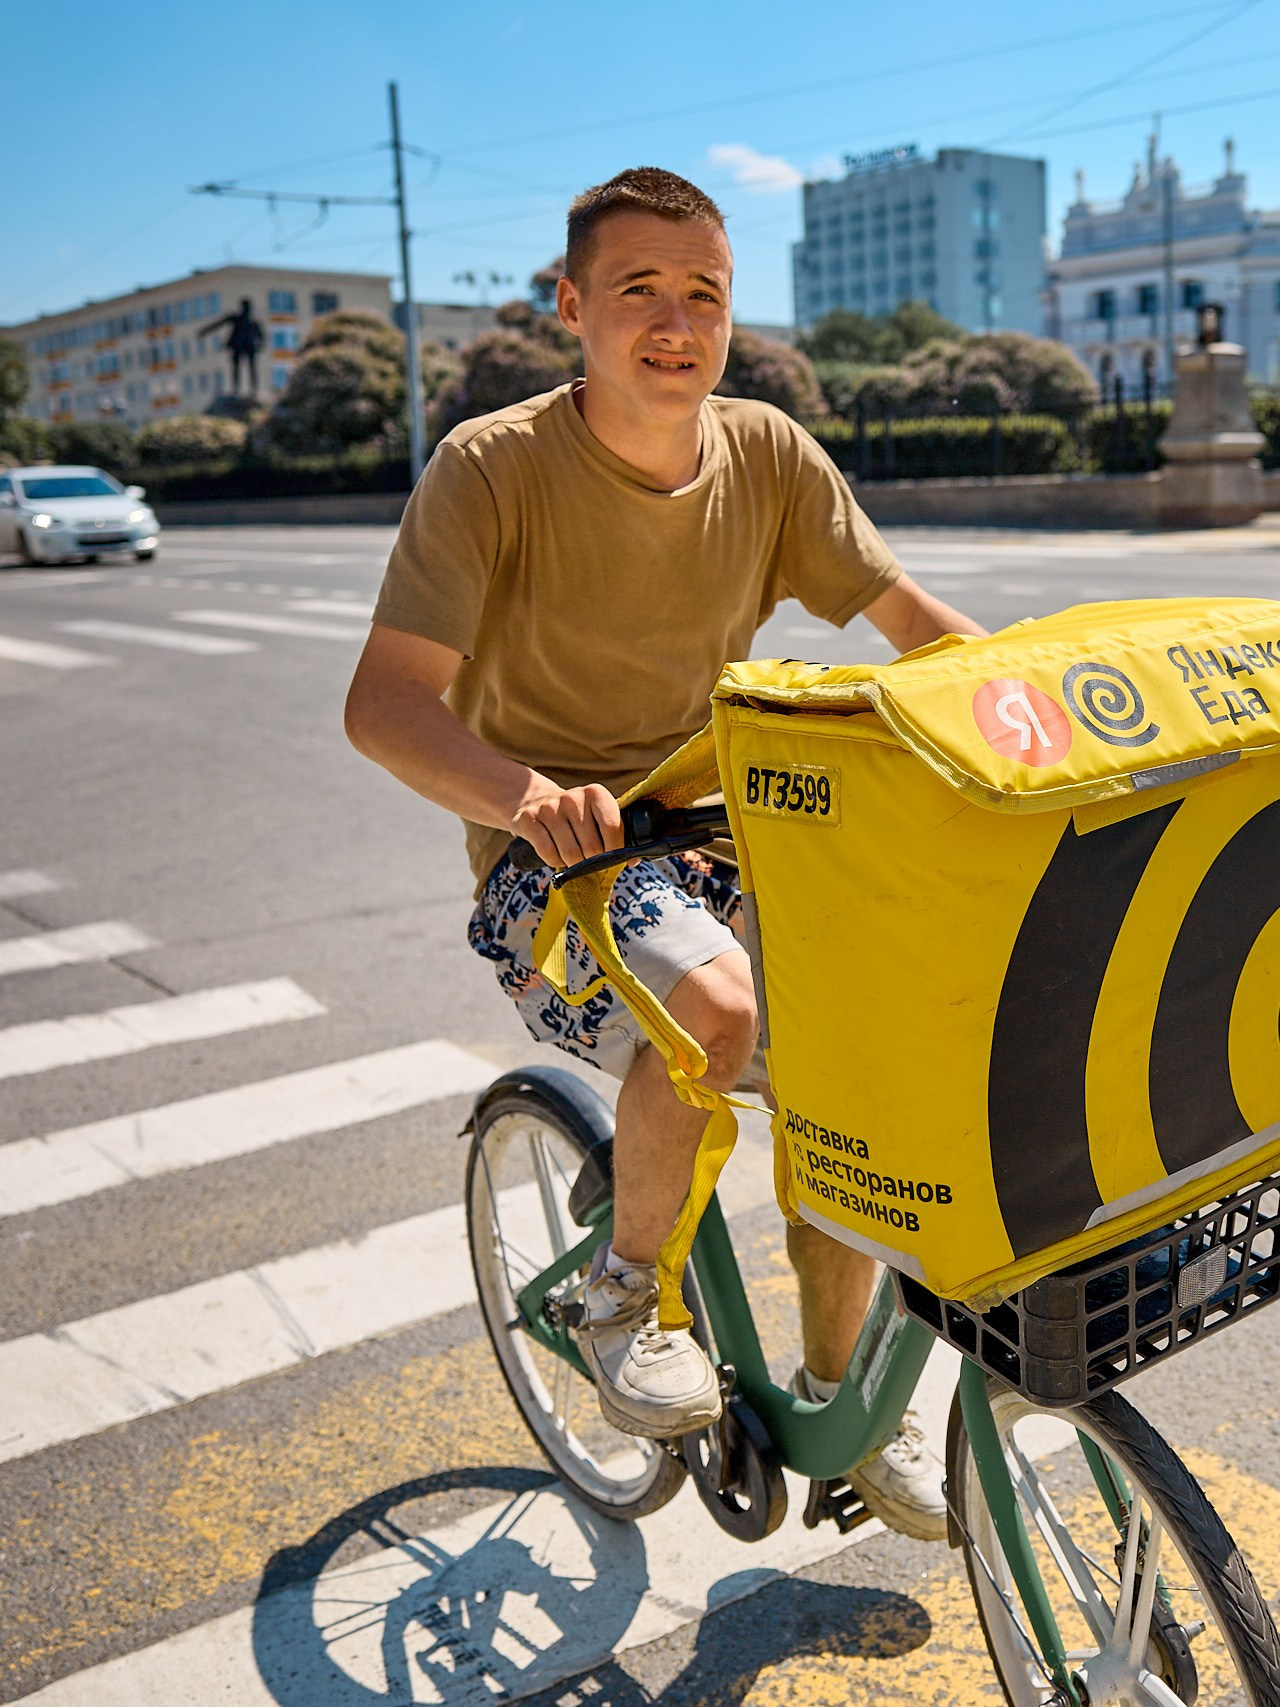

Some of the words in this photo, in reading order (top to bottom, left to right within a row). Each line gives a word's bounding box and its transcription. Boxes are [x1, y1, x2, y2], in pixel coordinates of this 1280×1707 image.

[995, 691, 1053, 751] Я
[1189, 685, 1271, 726] Еда
[785, 1107, 870, 1160] доставка
[804, 1172, 921, 1232] магазинов
[806, 1149, 953, 1204] ресторанов
